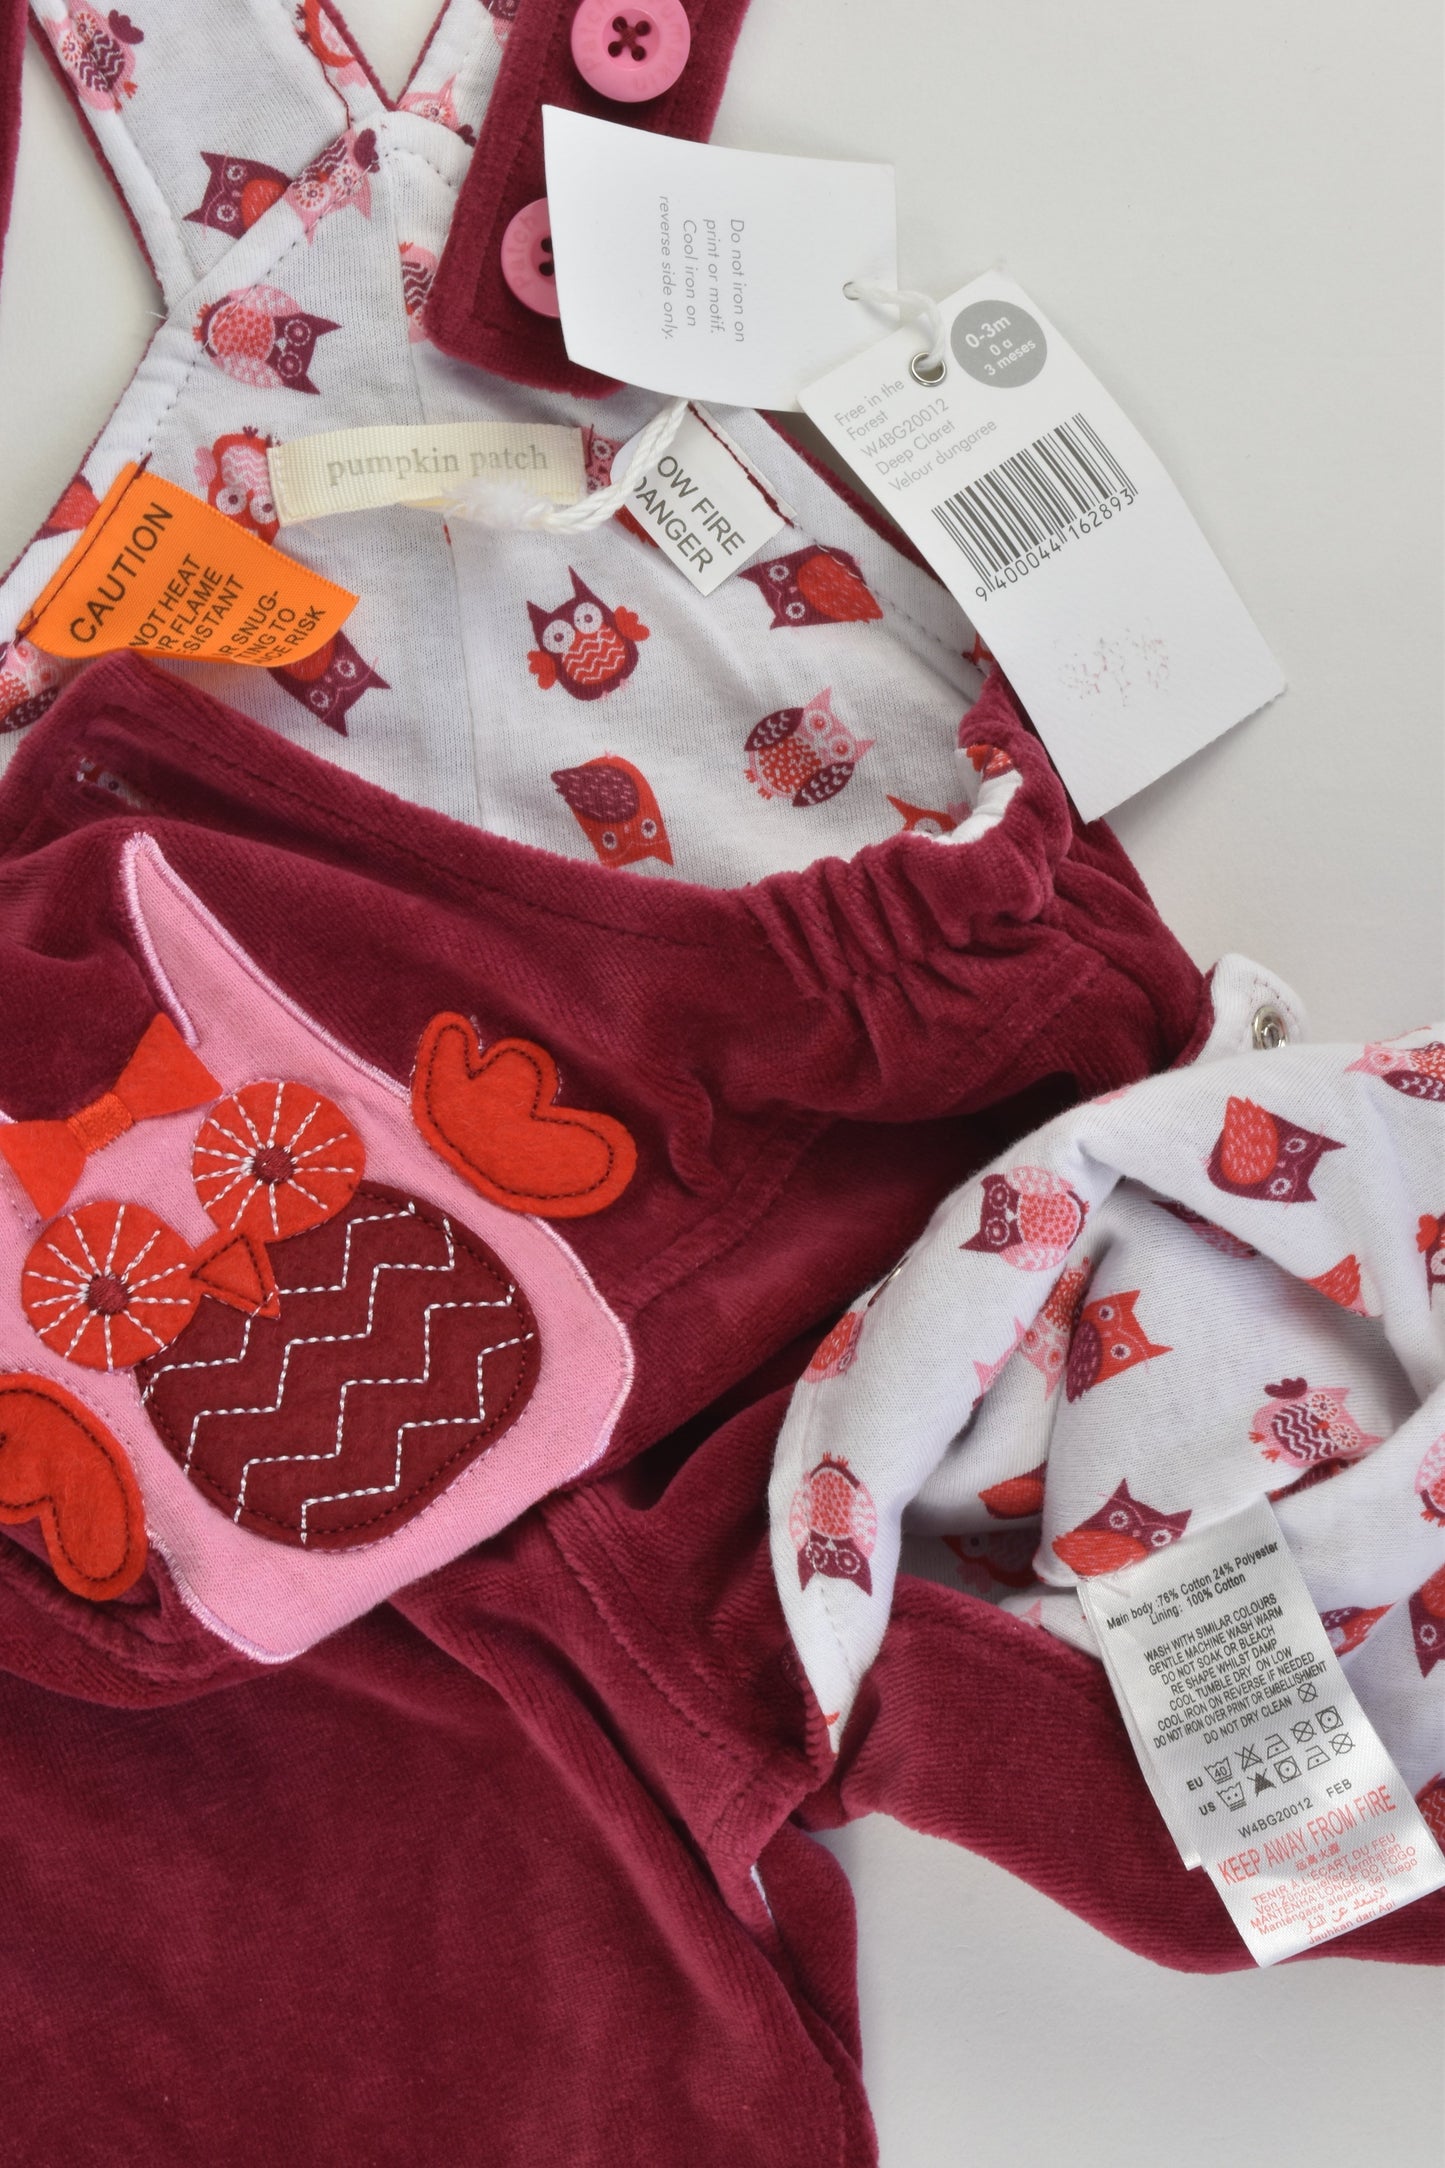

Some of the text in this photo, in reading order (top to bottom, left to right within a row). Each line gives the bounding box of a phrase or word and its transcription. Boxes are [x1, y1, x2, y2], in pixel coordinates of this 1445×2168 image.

[659, 195, 678, 340] reverse side only.
[683, 219, 699, 327] Cool iron on
[703, 218, 726, 333] print or motif.
[730, 219, 748, 342] Do not iron on
[965, 315, 1012, 348] 0-3m
[983, 339, 1036, 376] 3 meses
[1003, 338, 1014, 349] a
[834, 379, 905, 427] Free in the
[846, 410, 889, 441] Forest
[860, 398, 950, 458] W4BG20012
[327, 444, 549, 486] pumpkin patch
[875, 419, 956, 476] Deep Claret
[888, 420, 998, 492] Velour dungaree
[657, 455, 746, 556] OW FIRE
[70, 502, 173, 643] CAUTION
[158, 553, 201, 612] HEAT
[170, 566, 224, 636] FLAME
[176, 573, 245, 655] SISTANT
[231, 590, 280, 647] SNUG-
[233, 608, 296, 658] TING TO
[284, 605, 326, 647] RISK
[1106, 1613, 1130, 1630] Main
[1130, 1603, 1154, 1620] body
[1180, 1575, 1212, 1595] Cotton
[1213, 1562, 1235, 1580] 24%
[1234, 1541, 1279, 1569] Polyester
[1186, 1587, 1213, 1608] 100%
[1214, 1573, 1247, 1594] Cotton
[1143, 1593, 1277, 1662] WASH WITH SIMILAR COLOURS
[1149, 1606, 1284, 1676] GENTLE MACHINE WASH WARM
[1161, 1625, 1276, 1685] DO NOT SOAK OR BLEACH
[1157, 1651, 1315, 1732] COOL IRON ON REVERSE IF NEEDED
[1169, 1646, 1293, 1712] COOL TUMBLE DRY ON LOW
[1170, 1638, 1278, 1697] RE SHAPE WHILST DAMP
[1153, 1660, 1328, 1749] DO NOT IRON OVER PRINT OR EMBELLISHMENT
[1203, 1695, 1293, 1744] DO NOT DRY CLEAN
[1186, 1765, 1227, 1791] EU 40
[1237, 1778, 1353, 1838] W4BG20012 FEB
[1199, 1802, 1217, 1816] US
[1217, 1785, 1396, 1886] KEEP AWAY FROM FIRE
[1250, 1845, 1416, 1929] MANTENHA LONGE DO FOGO
[1251, 1884, 1288, 1906] TENIR
[1352, 1845, 1370, 1860] DU
[1372, 1832, 1396, 1850] FEU
[1327, 1884, 1366, 1907] alejado
[1369, 1872, 1385, 1887] del
[1386, 1858, 1418, 1879] fuego
[1256, 1901, 1278, 1915] Von
[1309, 1900, 1396, 1945] Jauhkan dari Api
